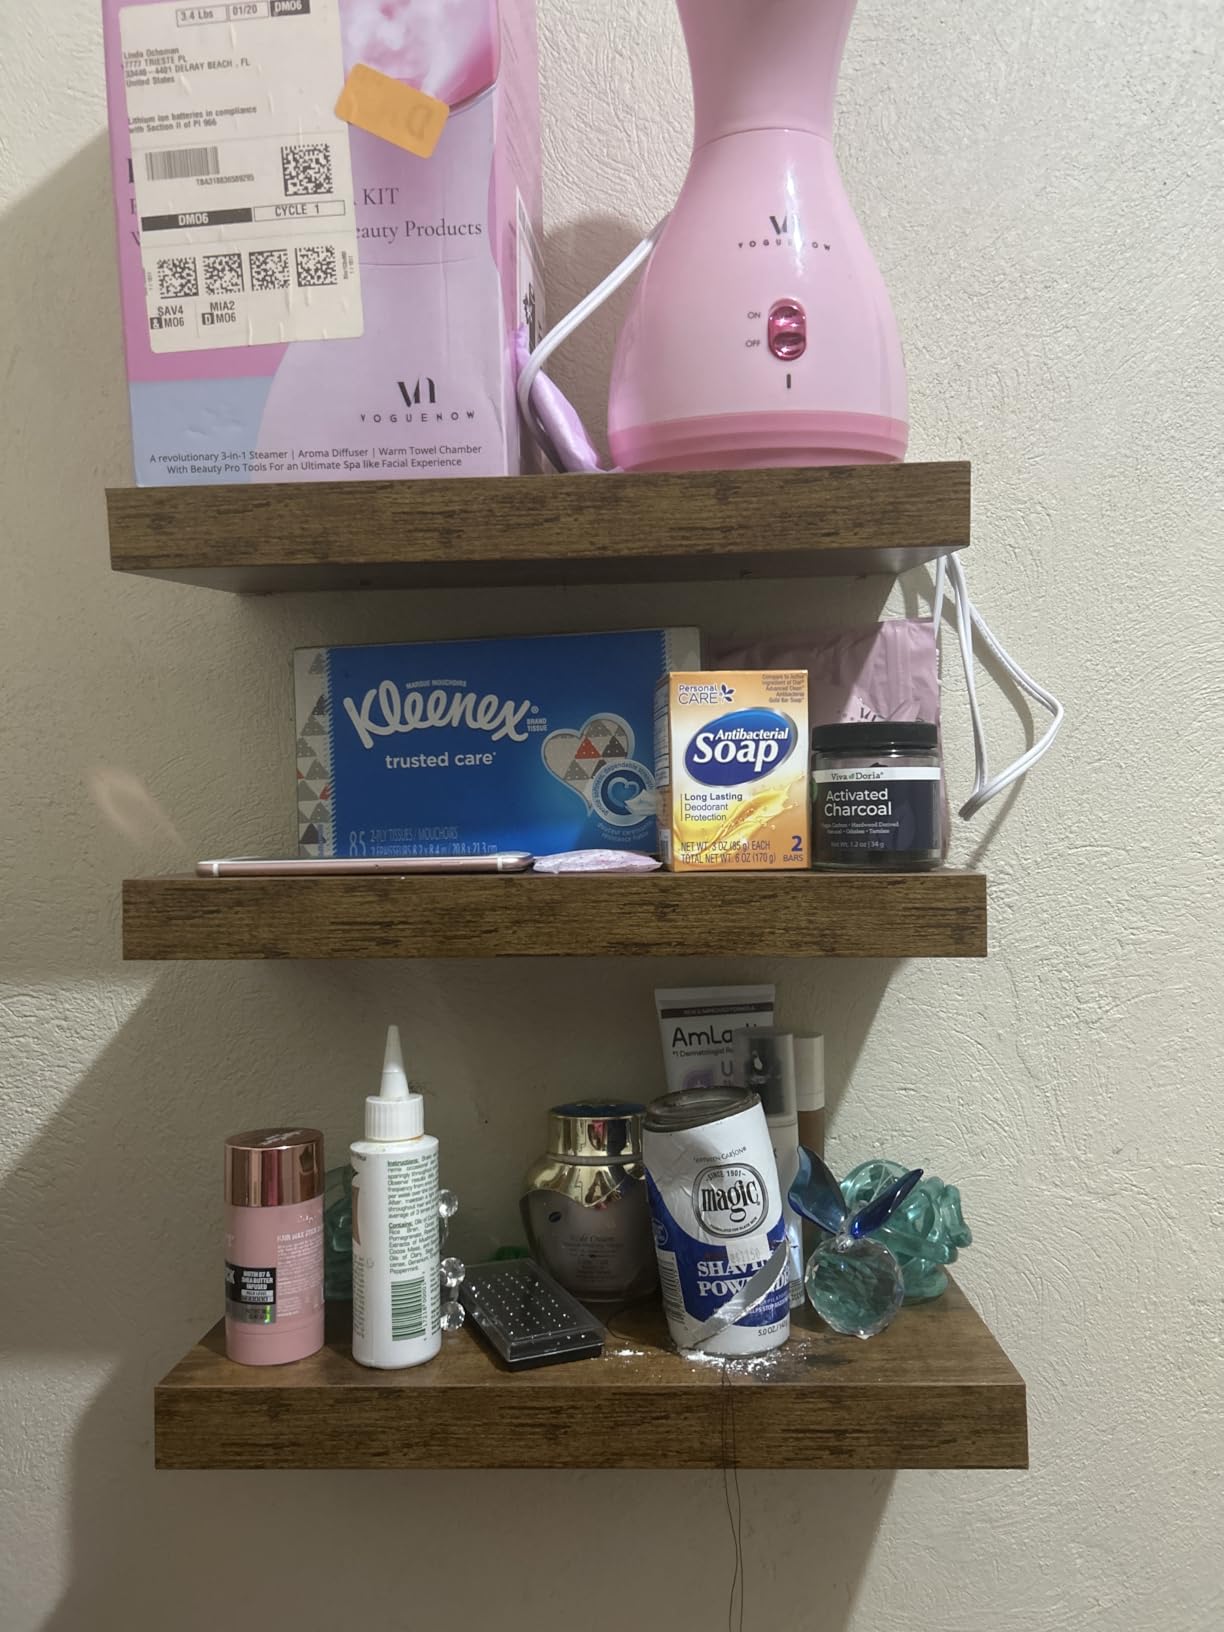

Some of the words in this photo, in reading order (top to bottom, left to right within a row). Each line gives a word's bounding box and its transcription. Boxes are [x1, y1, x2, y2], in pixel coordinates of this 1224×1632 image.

[198, 10, 213, 20] Lbs
[232, 5, 257, 16] 01/20
[178, 55, 187, 63] PL
[175, 63, 205, 73] DELRAY
[207, 60, 232, 69] BEACH
[240, 58, 250, 66] FL
[127, 79, 150, 87] United
[152, 76, 175, 85] States
[128, 116, 155, 125] Lithium
[172, 110, 203, 120] batteries
[215, 106, 257, 117] compliance
[129, 125, 144, 133] with
[147, 122, 173, 132] Section
[363, 187, 399, 205] KIT
[275, 204, 308, 217] CYCLE
[315, 204, 320, 214] 1
[405, 218, 482, 238] Products
[157, 305, 184, 317] SAV4
[210, 300, 235, 313] MIA2
[747, 312, 761, 320] ON
[745, 339, 761, 348] OFF
[150, 455, 156, 463] A
[158, 452, 219, 462] revolutionary
[221, 452, 246, 460] 3-in-1
[249, 450, 288, 460] Steamer
[298, 449, 329, 458] Aroma
[332, 448, 368, 457] Diffuser
[378, 447, 407, 456] Warm
[410, 446, 437, 455] Towel
[440, 445, 482, 455] Chamber
[167, 466, 188, 475] With
[190, 465, 222, 475] Beauty
[224, 464, 240, 472] Pro
[242, 463, 267, 472] Tools
[269, 463, 284, 471] For
[301, 461, 341, 471] Ultimate
[344, 460, 360, 471] Spa
[364, 459, 380, 469] like
[382, 459, 408, 468] Facial
[411, 458, 462, 469] Experience
[679, 685, 717, 693] Personal
[678, 693, 718, 704] CARE
[716, 727, 789, 741] Antibacterial
[693, 731, 779, 772] Soap
[385, 752, 449, 770] trusted
[832, 773, 847, 781] Viva
[684, 794, 707, 803] Long
[710, 793, 743, 803] Lasting
[826, 788, 888, 801] Activated
[684, 803, 728, 811] Deodorant
[824, 801, 892, 816] Charcoal
[684, 813, 727, 822] Protection
[390, 829, 412, 841] TISSUES
[350, 831, 366, 857] 85
[681, 842, 695, 851] NET
[712, 842, 717, 851] 3
[719, 842, 729, 851] OZ
[730, 841, 741, 852] (85
[751, 841, 770, 850] EACH
[791, 836, 803, 852] 2
[681, 854, 703, 864] TOTAL
[705, 854, 718, 863] NET
[735, 853, 740, 862] 6
[741, 853, 751, 863] OZ
[752, 852, 766, 863] (170
[783, 854, 804, 862] BARS
[708, 1170, 724, 1181] SINCE
[702, 1180, 759, 1223] magic
[758, 1329, 767, 1337] 5.0
